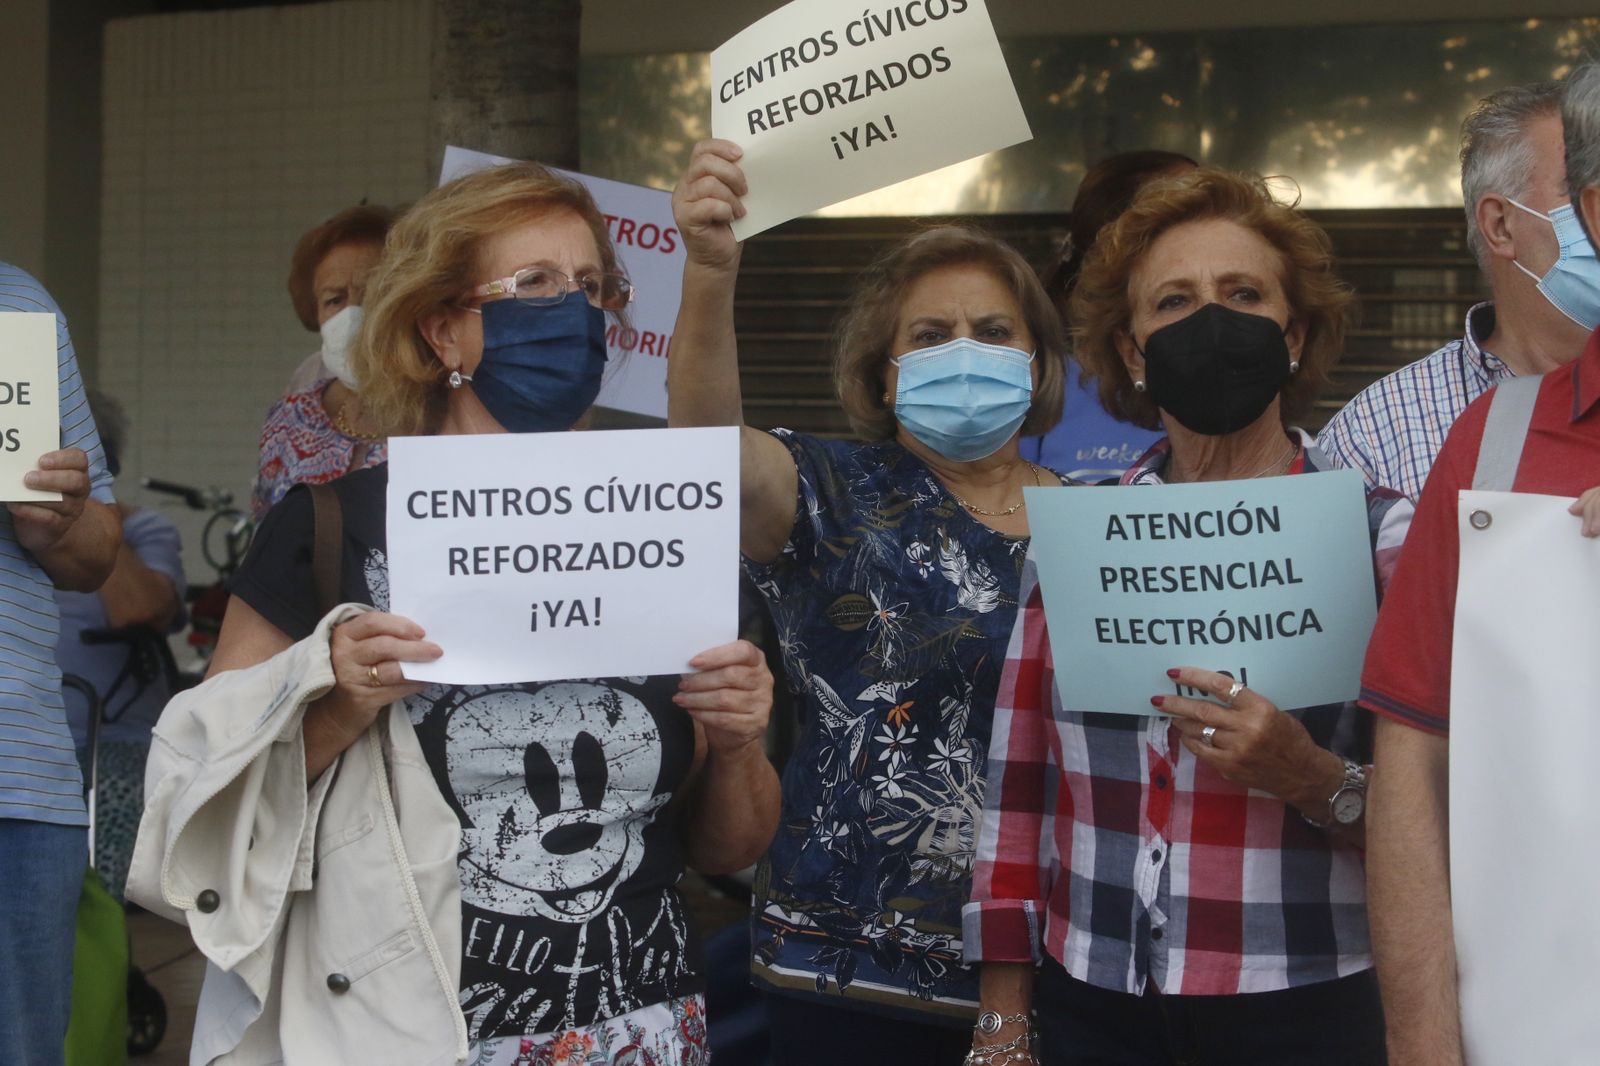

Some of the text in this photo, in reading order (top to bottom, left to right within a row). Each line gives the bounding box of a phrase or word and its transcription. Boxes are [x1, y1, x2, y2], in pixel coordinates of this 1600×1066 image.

[719, 30, 839, 104] CENTROS
[747, 46, 952, 135] REFORZADOS
[830, 114, 898, 160] ¡YA!
[0, 428, 21, 453] S
[407, 476, 723, 520] CENTROS CÍVICOS
[1105, 500, 1281, 541] ATENCIÓN
[448, 539, 685, 576] REFORZADOS
[1099, 558, 1303, 594] PRESENCIAL
[530, 597, 601, 633] ¡YA!
[1094, 608, 1324, 646] ELECTRÓNICA
